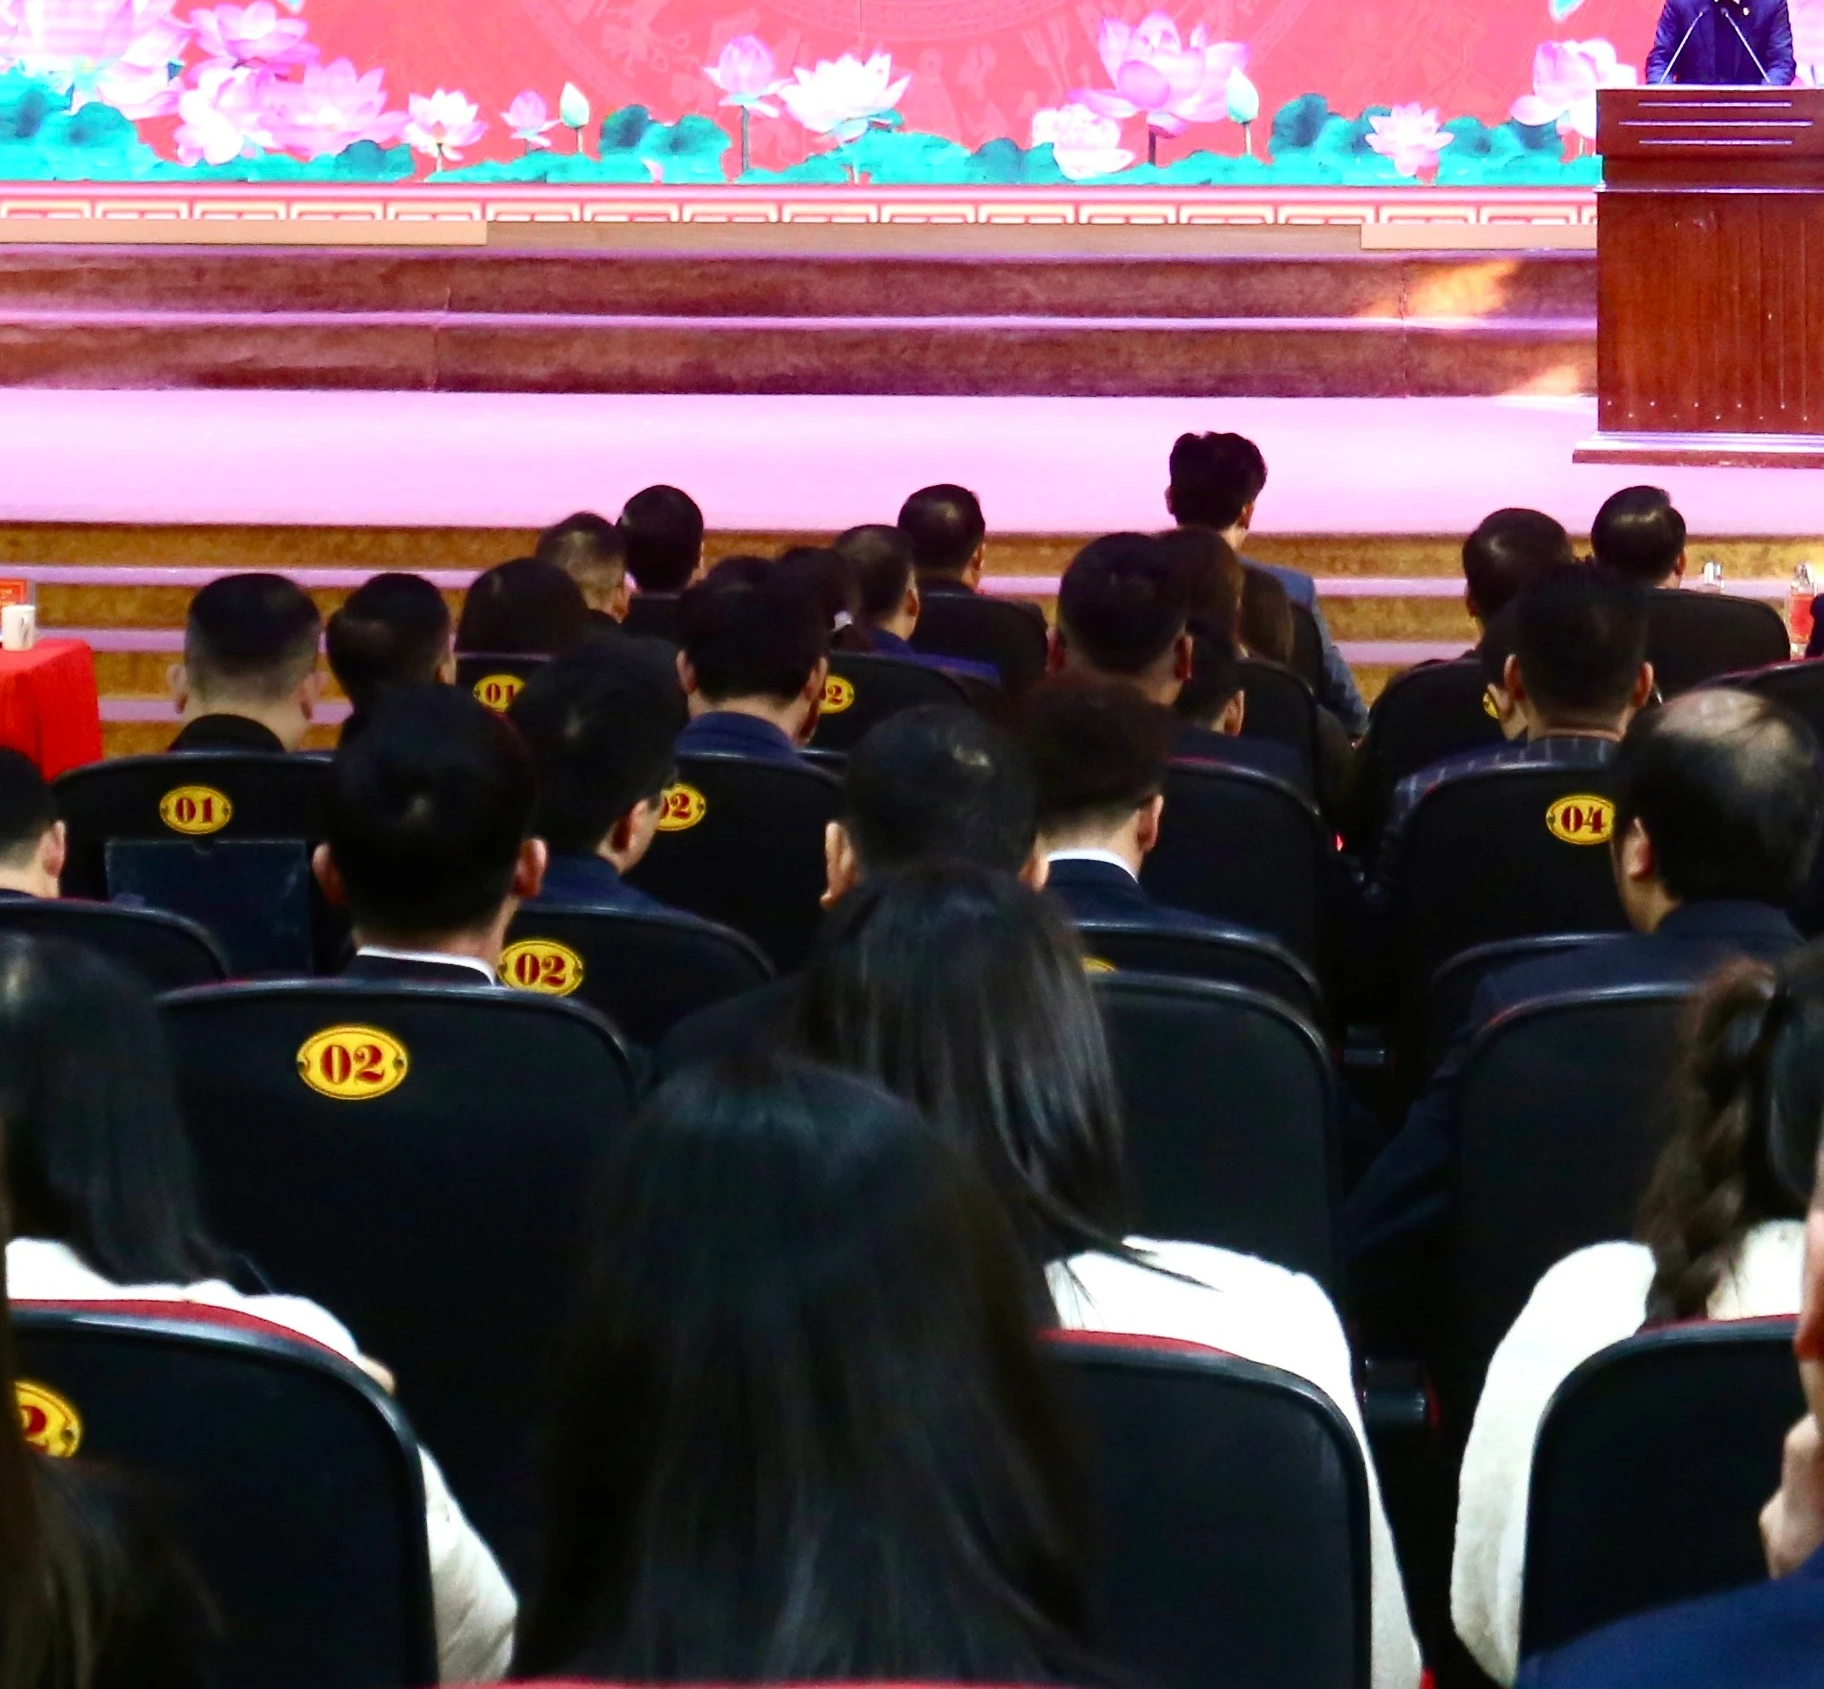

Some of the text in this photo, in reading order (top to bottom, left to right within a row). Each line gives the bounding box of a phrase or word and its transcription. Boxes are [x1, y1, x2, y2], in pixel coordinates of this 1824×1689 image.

[174, 796, 214, 824] 01
[1560, 805, 1606, 834] 04
[515, 953, 566, 988] 02
[320, 1044, 386, 1084] 02
